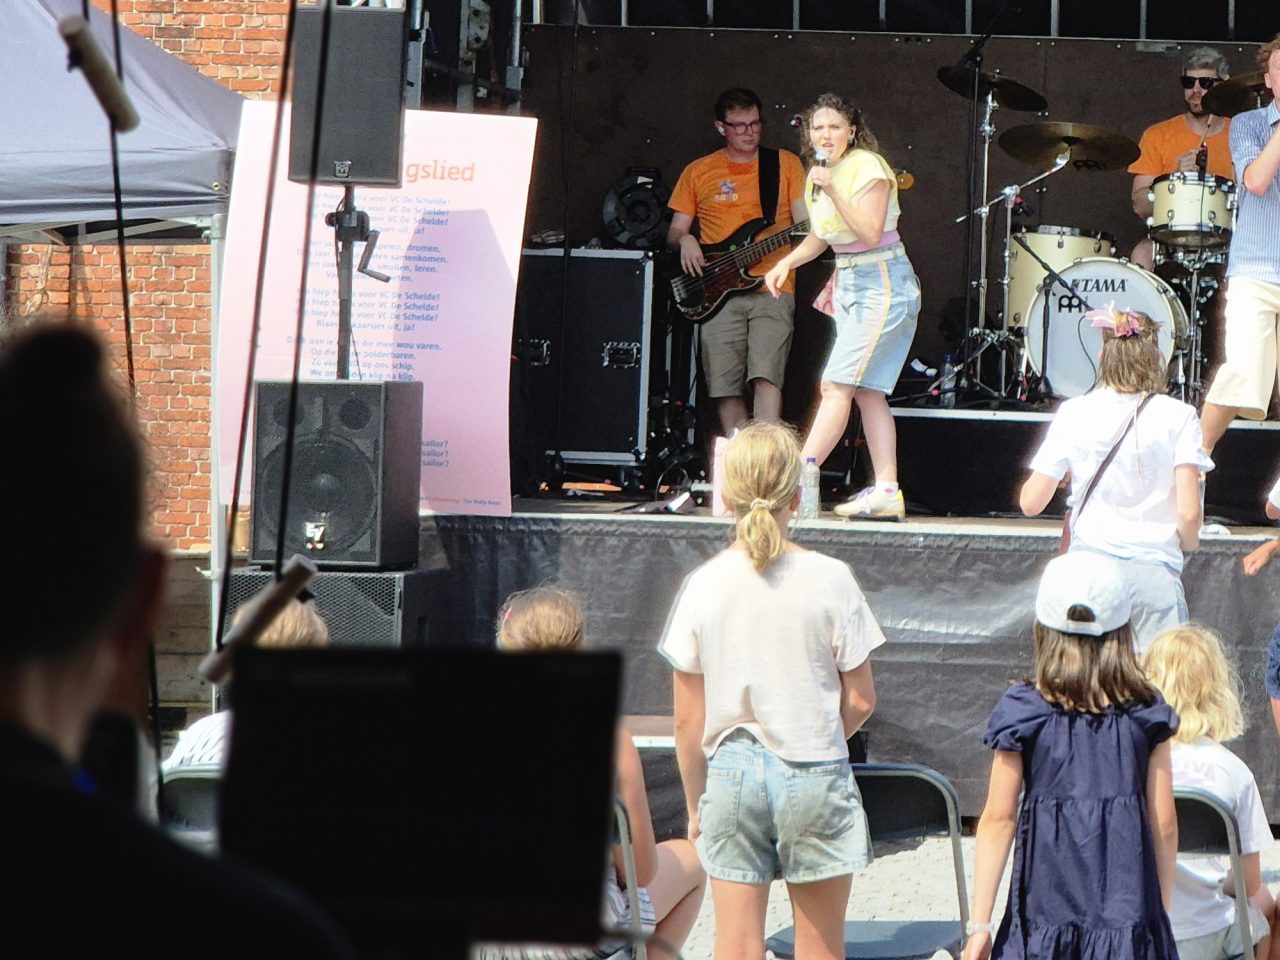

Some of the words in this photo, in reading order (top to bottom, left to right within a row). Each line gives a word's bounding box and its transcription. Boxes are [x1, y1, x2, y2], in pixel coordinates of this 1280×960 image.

[406, 160, 476, 183] gslied
[1081, 279, 1127, 293] TAMA
[404, 292, 440, 301] Schelde!
[391, 302, 401, 310] De
[403, 302, 439, 311] Schelde!
[402, 312, 438, 321] Schelde!
[416, 342, 442, 350] varen.
